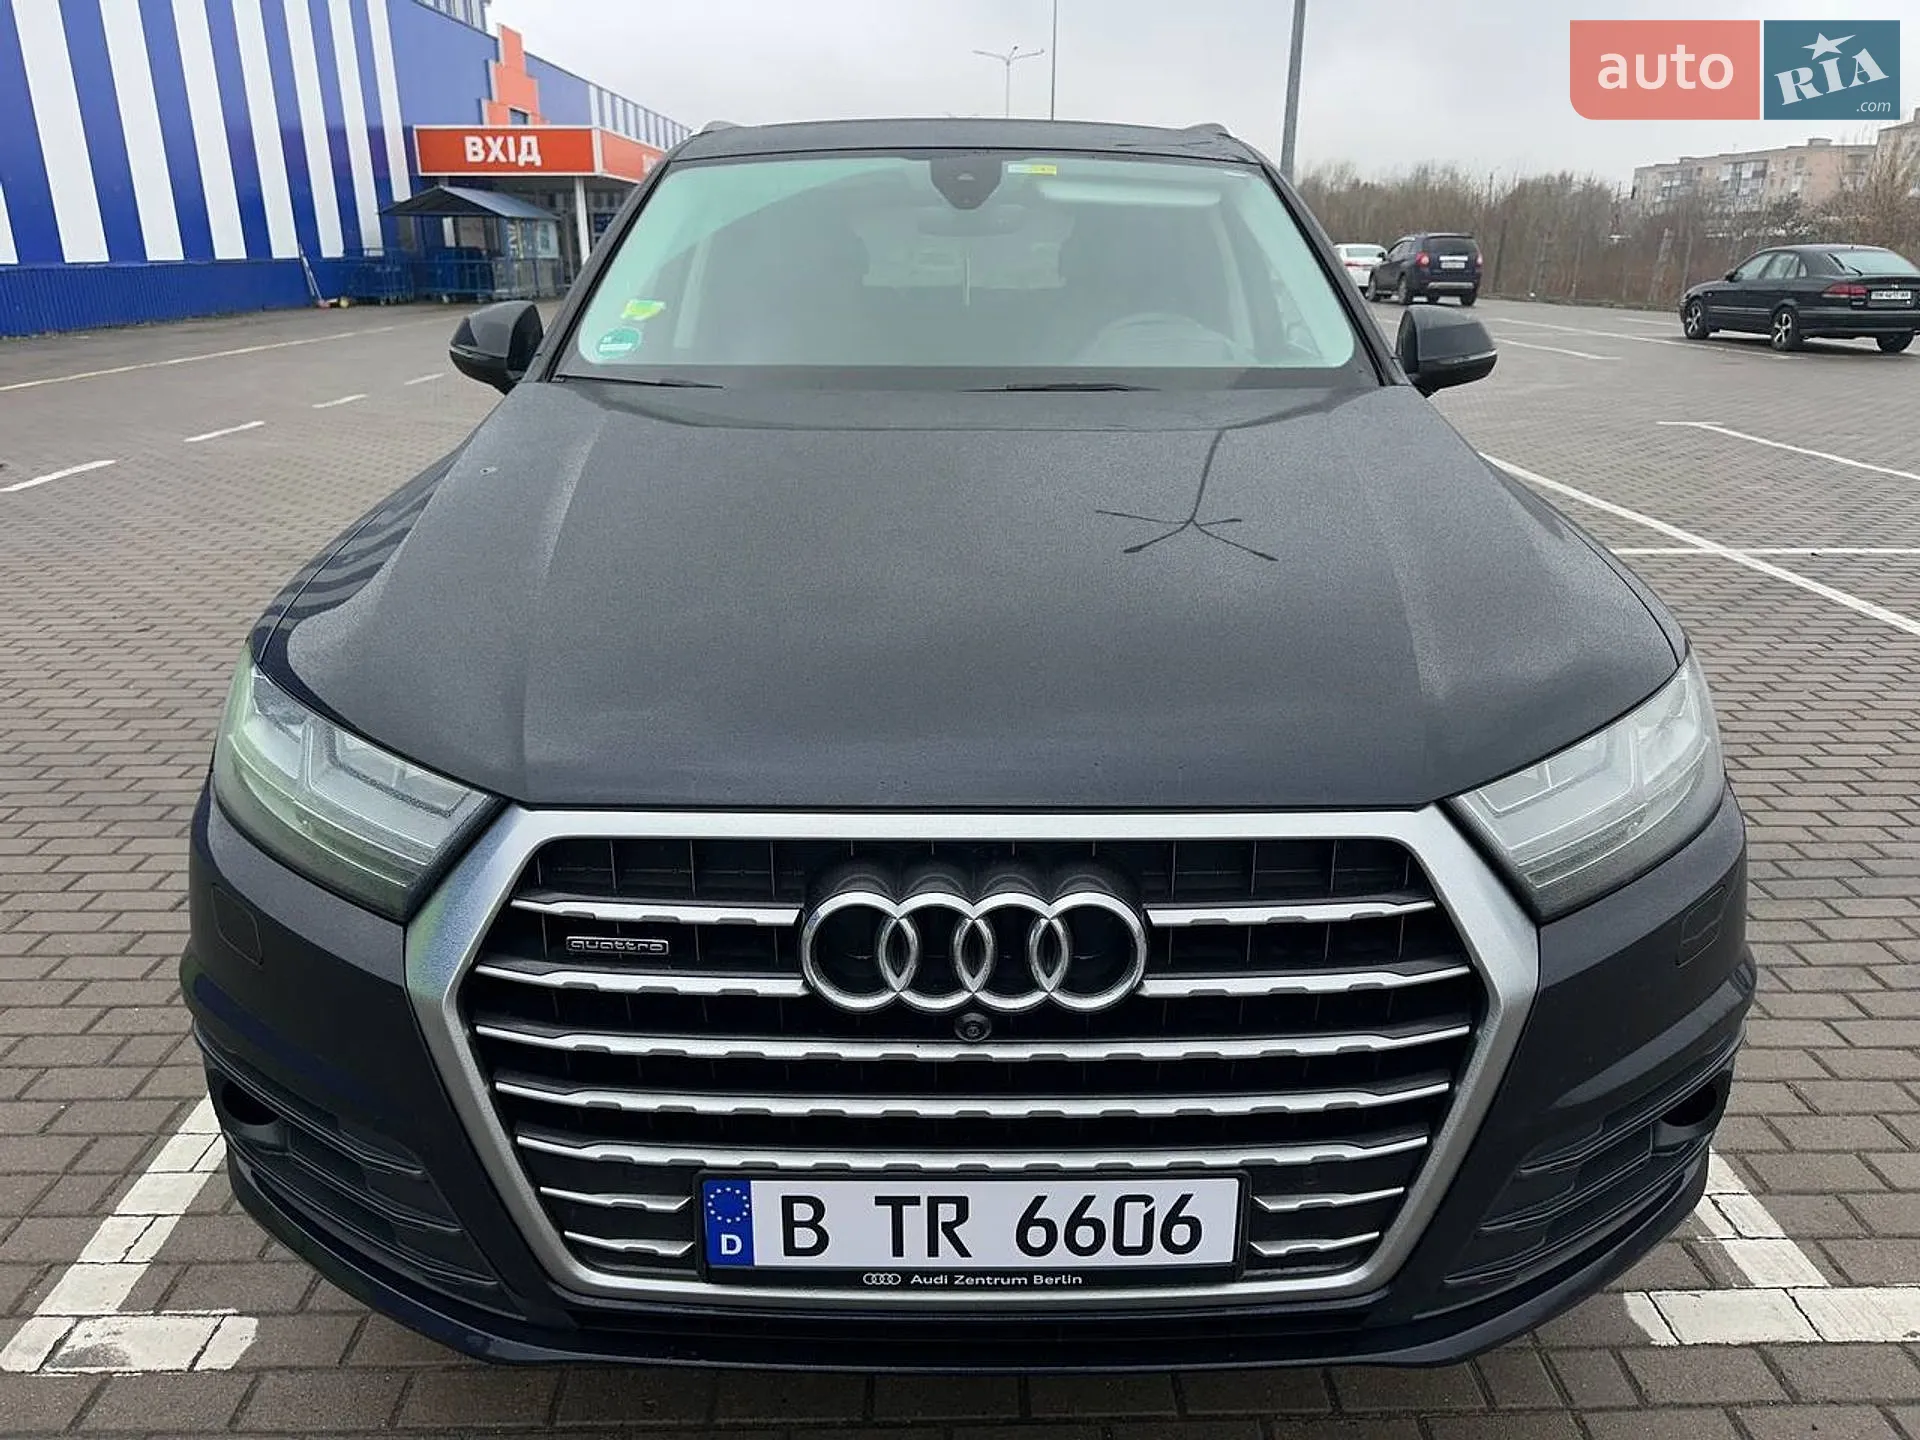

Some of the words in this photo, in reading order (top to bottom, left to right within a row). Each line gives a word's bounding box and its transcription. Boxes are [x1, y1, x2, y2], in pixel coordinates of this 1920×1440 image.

[464, 135, 542, 166] ВХІД
[570, 940, 664, 952] quattro
[780, 1195, 830, 1257] B
[874, 1195, 973, 1258] TR
[1015, 1193, 1203, 1257] 6606
[720, 1233, 742, 1255] D
[910, 1274, 948, 1285] Audi
[953, 1274, 1028, 1286] Zentrum
[1033, 1274, 1083, 1285] Berlin
